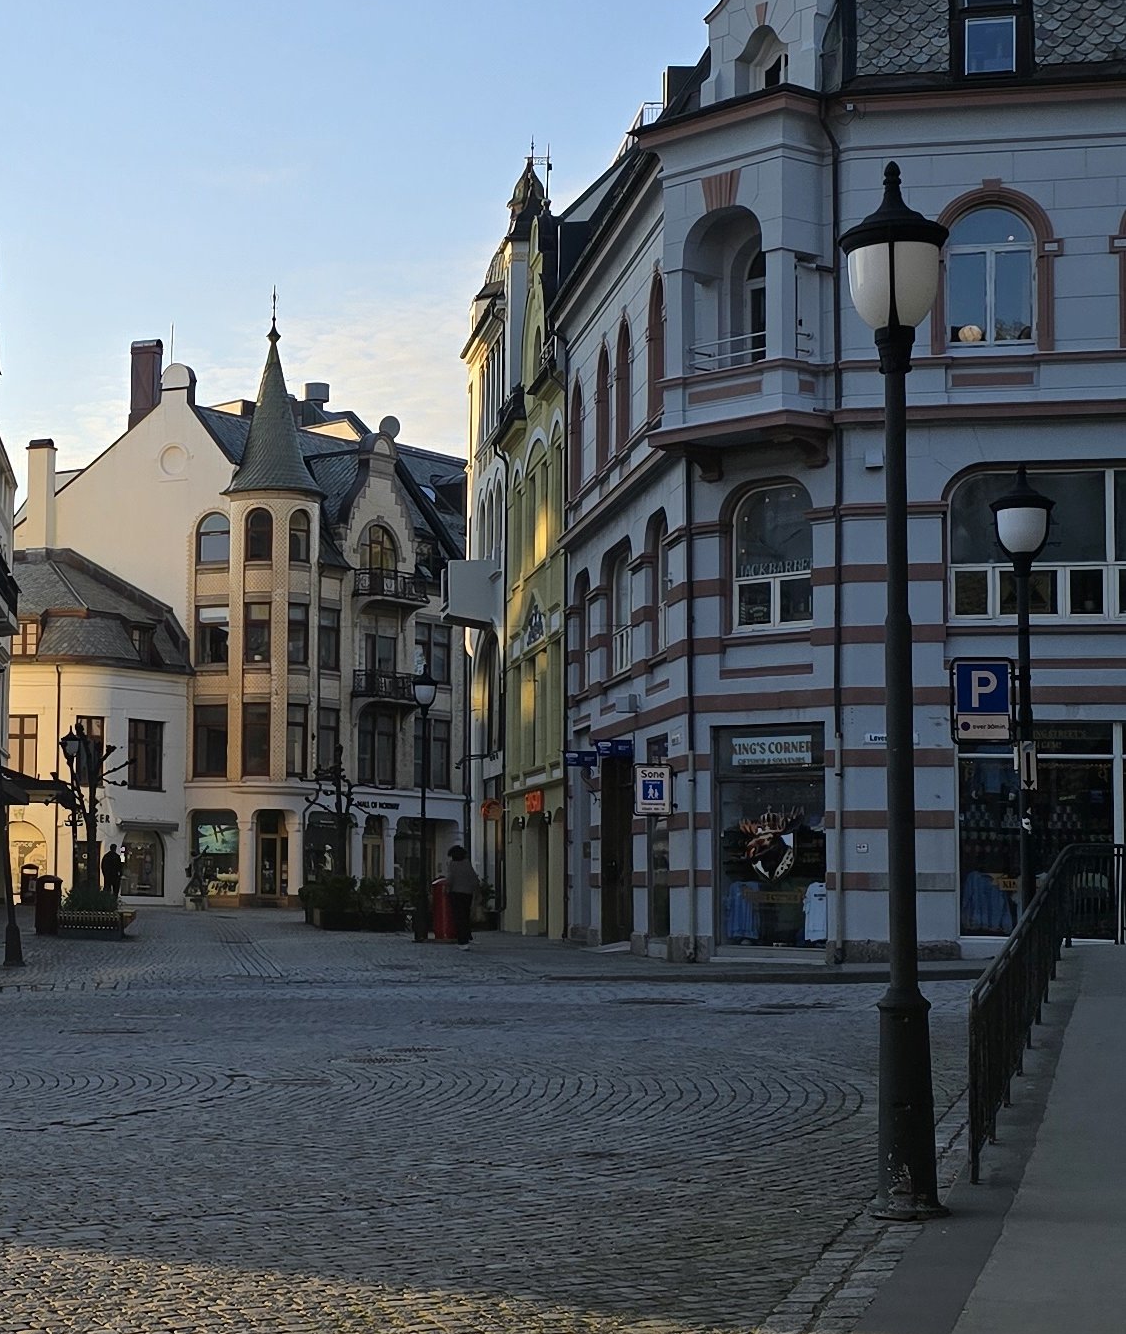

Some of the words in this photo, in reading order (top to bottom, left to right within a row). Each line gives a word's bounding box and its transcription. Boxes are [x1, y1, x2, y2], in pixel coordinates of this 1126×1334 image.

[971, 670, 998, 708] P
[731, 742, 766, 756] KING'S
[640, 769, 665, 778] Sone
